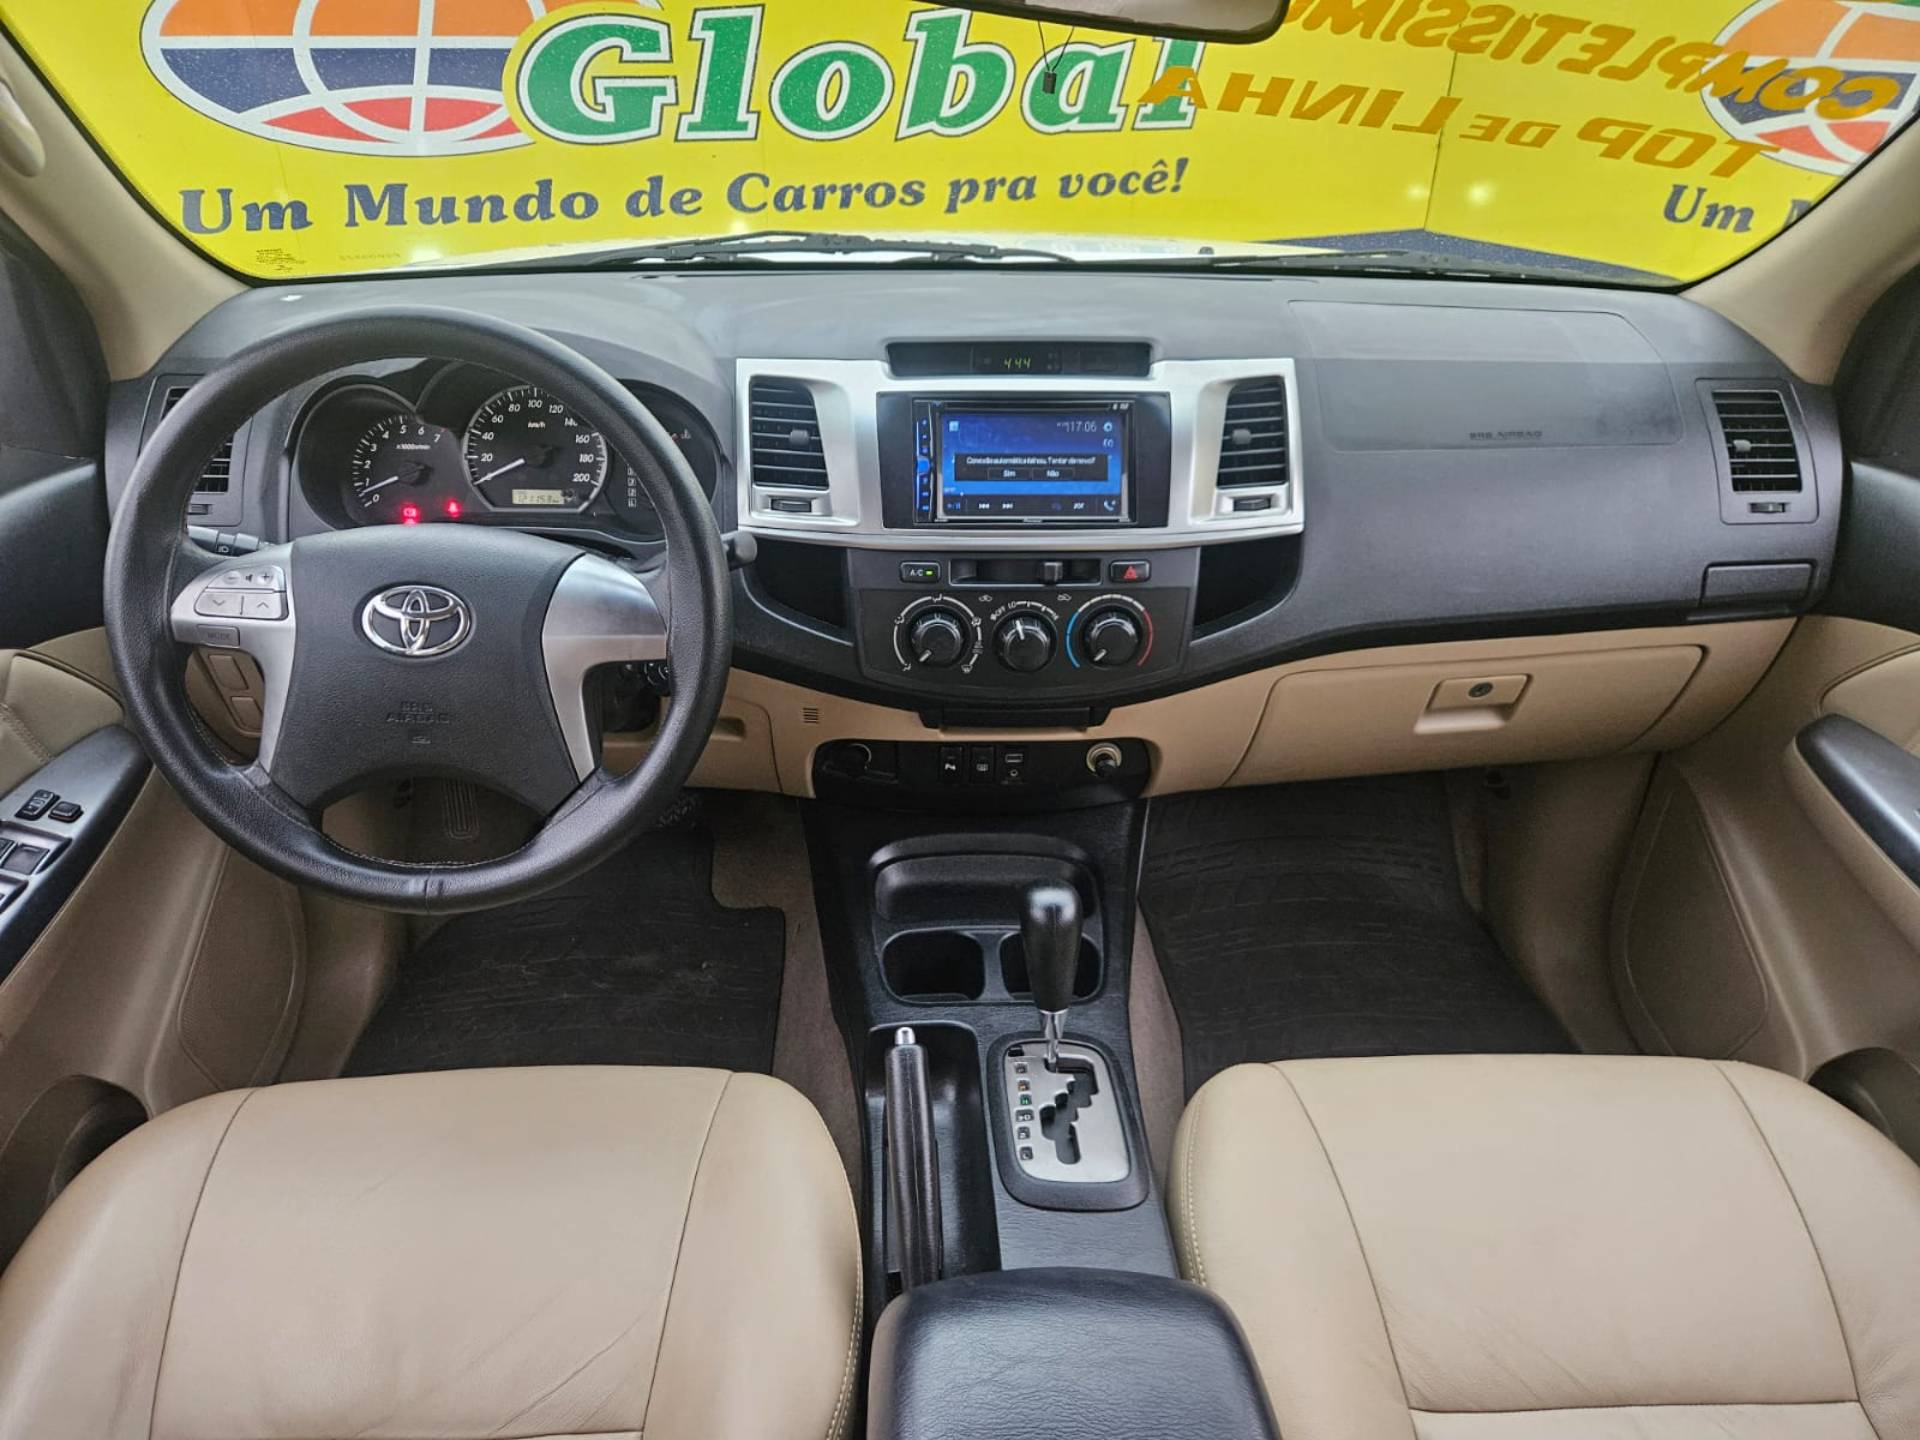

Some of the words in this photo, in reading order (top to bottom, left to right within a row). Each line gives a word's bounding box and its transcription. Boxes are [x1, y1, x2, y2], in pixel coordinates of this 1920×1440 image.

[516, 3, 1207, 145] Global
[179, 188, 314, 234] Um
[344, 178, 600, 228] Mundo
[624, 175, 703, 218] de
[726, 172, 926, 213] Carros
[944, 175, 1037, 214] pra
[1057, 157, 1190, 198] você!
[1663, 184, 1754, 233] Um
[508, 403, 521, 413] 80
[527, 400, 543, 409] 100
[548, 404, 564, 414] 120
[491, 414, 504, 423] 60
[400, 425, 407, 434] 5
[418, 426, 425, 435] 6
[433, 433, 441, 443] 7
[481, 431, 495, 441] 40
[575, 434, 590, 444] 160
[370, 443, 377, 452] 3
[480, 452, 493, 462] 20
[579, 453, 594, 463] 180
[363, 460, 371, 469] 2
[572, 472, 590, 482] 200
[372, 493, 380, 503] 0
